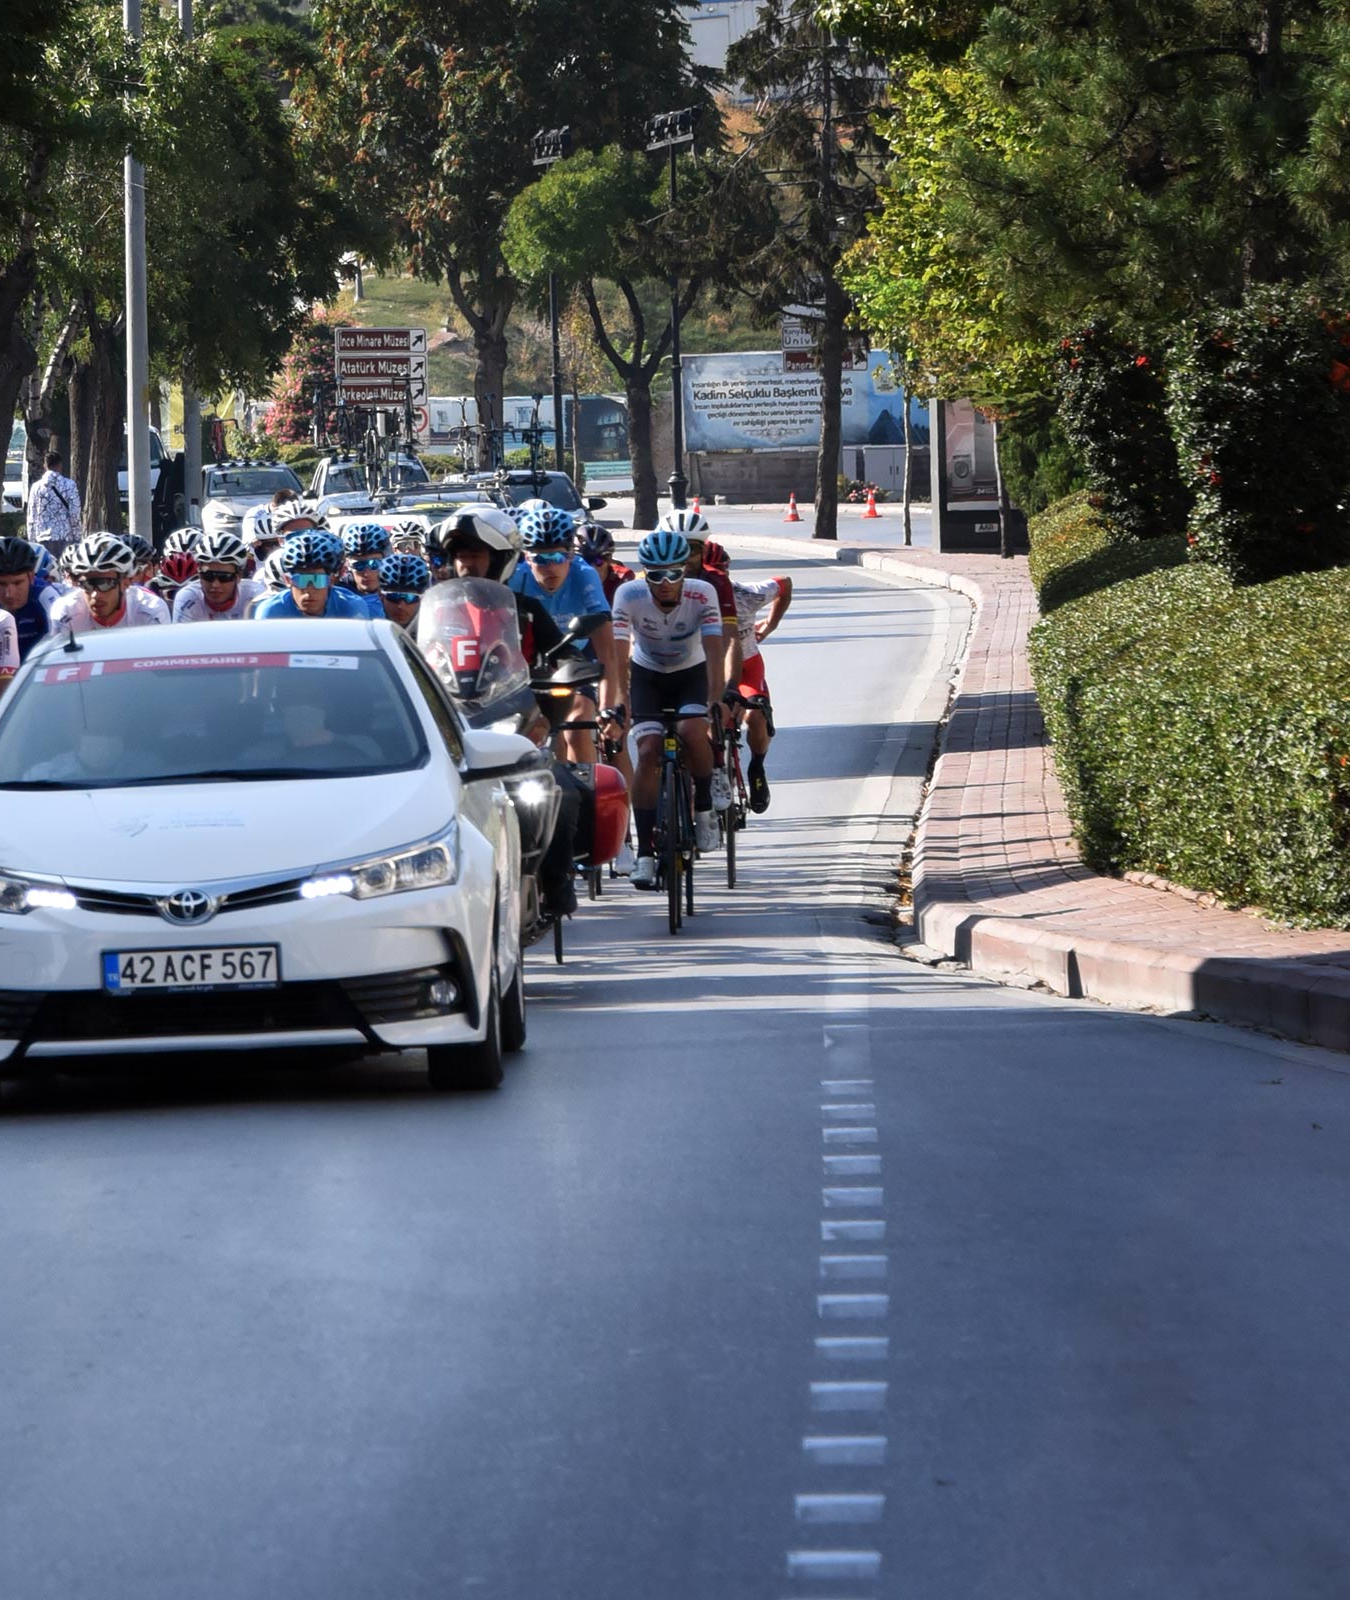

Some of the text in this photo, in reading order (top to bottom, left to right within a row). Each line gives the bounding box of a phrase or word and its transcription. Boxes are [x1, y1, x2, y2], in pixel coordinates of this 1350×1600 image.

[356, 334, 382, 347] Minare
[383, 333, 410, 347] Müzesi
[340, 360, 410, 374] Atatürk Müzesi
[693, 389, 727, 400] Kadim
[728, 388, 771, 401] Selçuklu
[772, 387, 818, 400] Başkenti
[456, 640, 478, 666] F
[133, 656, 258, 668] COMMISSAIRE 2
[57, 667, 81, 681] F
[121, 956, 156, 984] 42
[163, 953, 213, 982] ACF
[221, 950, 274, 980] 567
